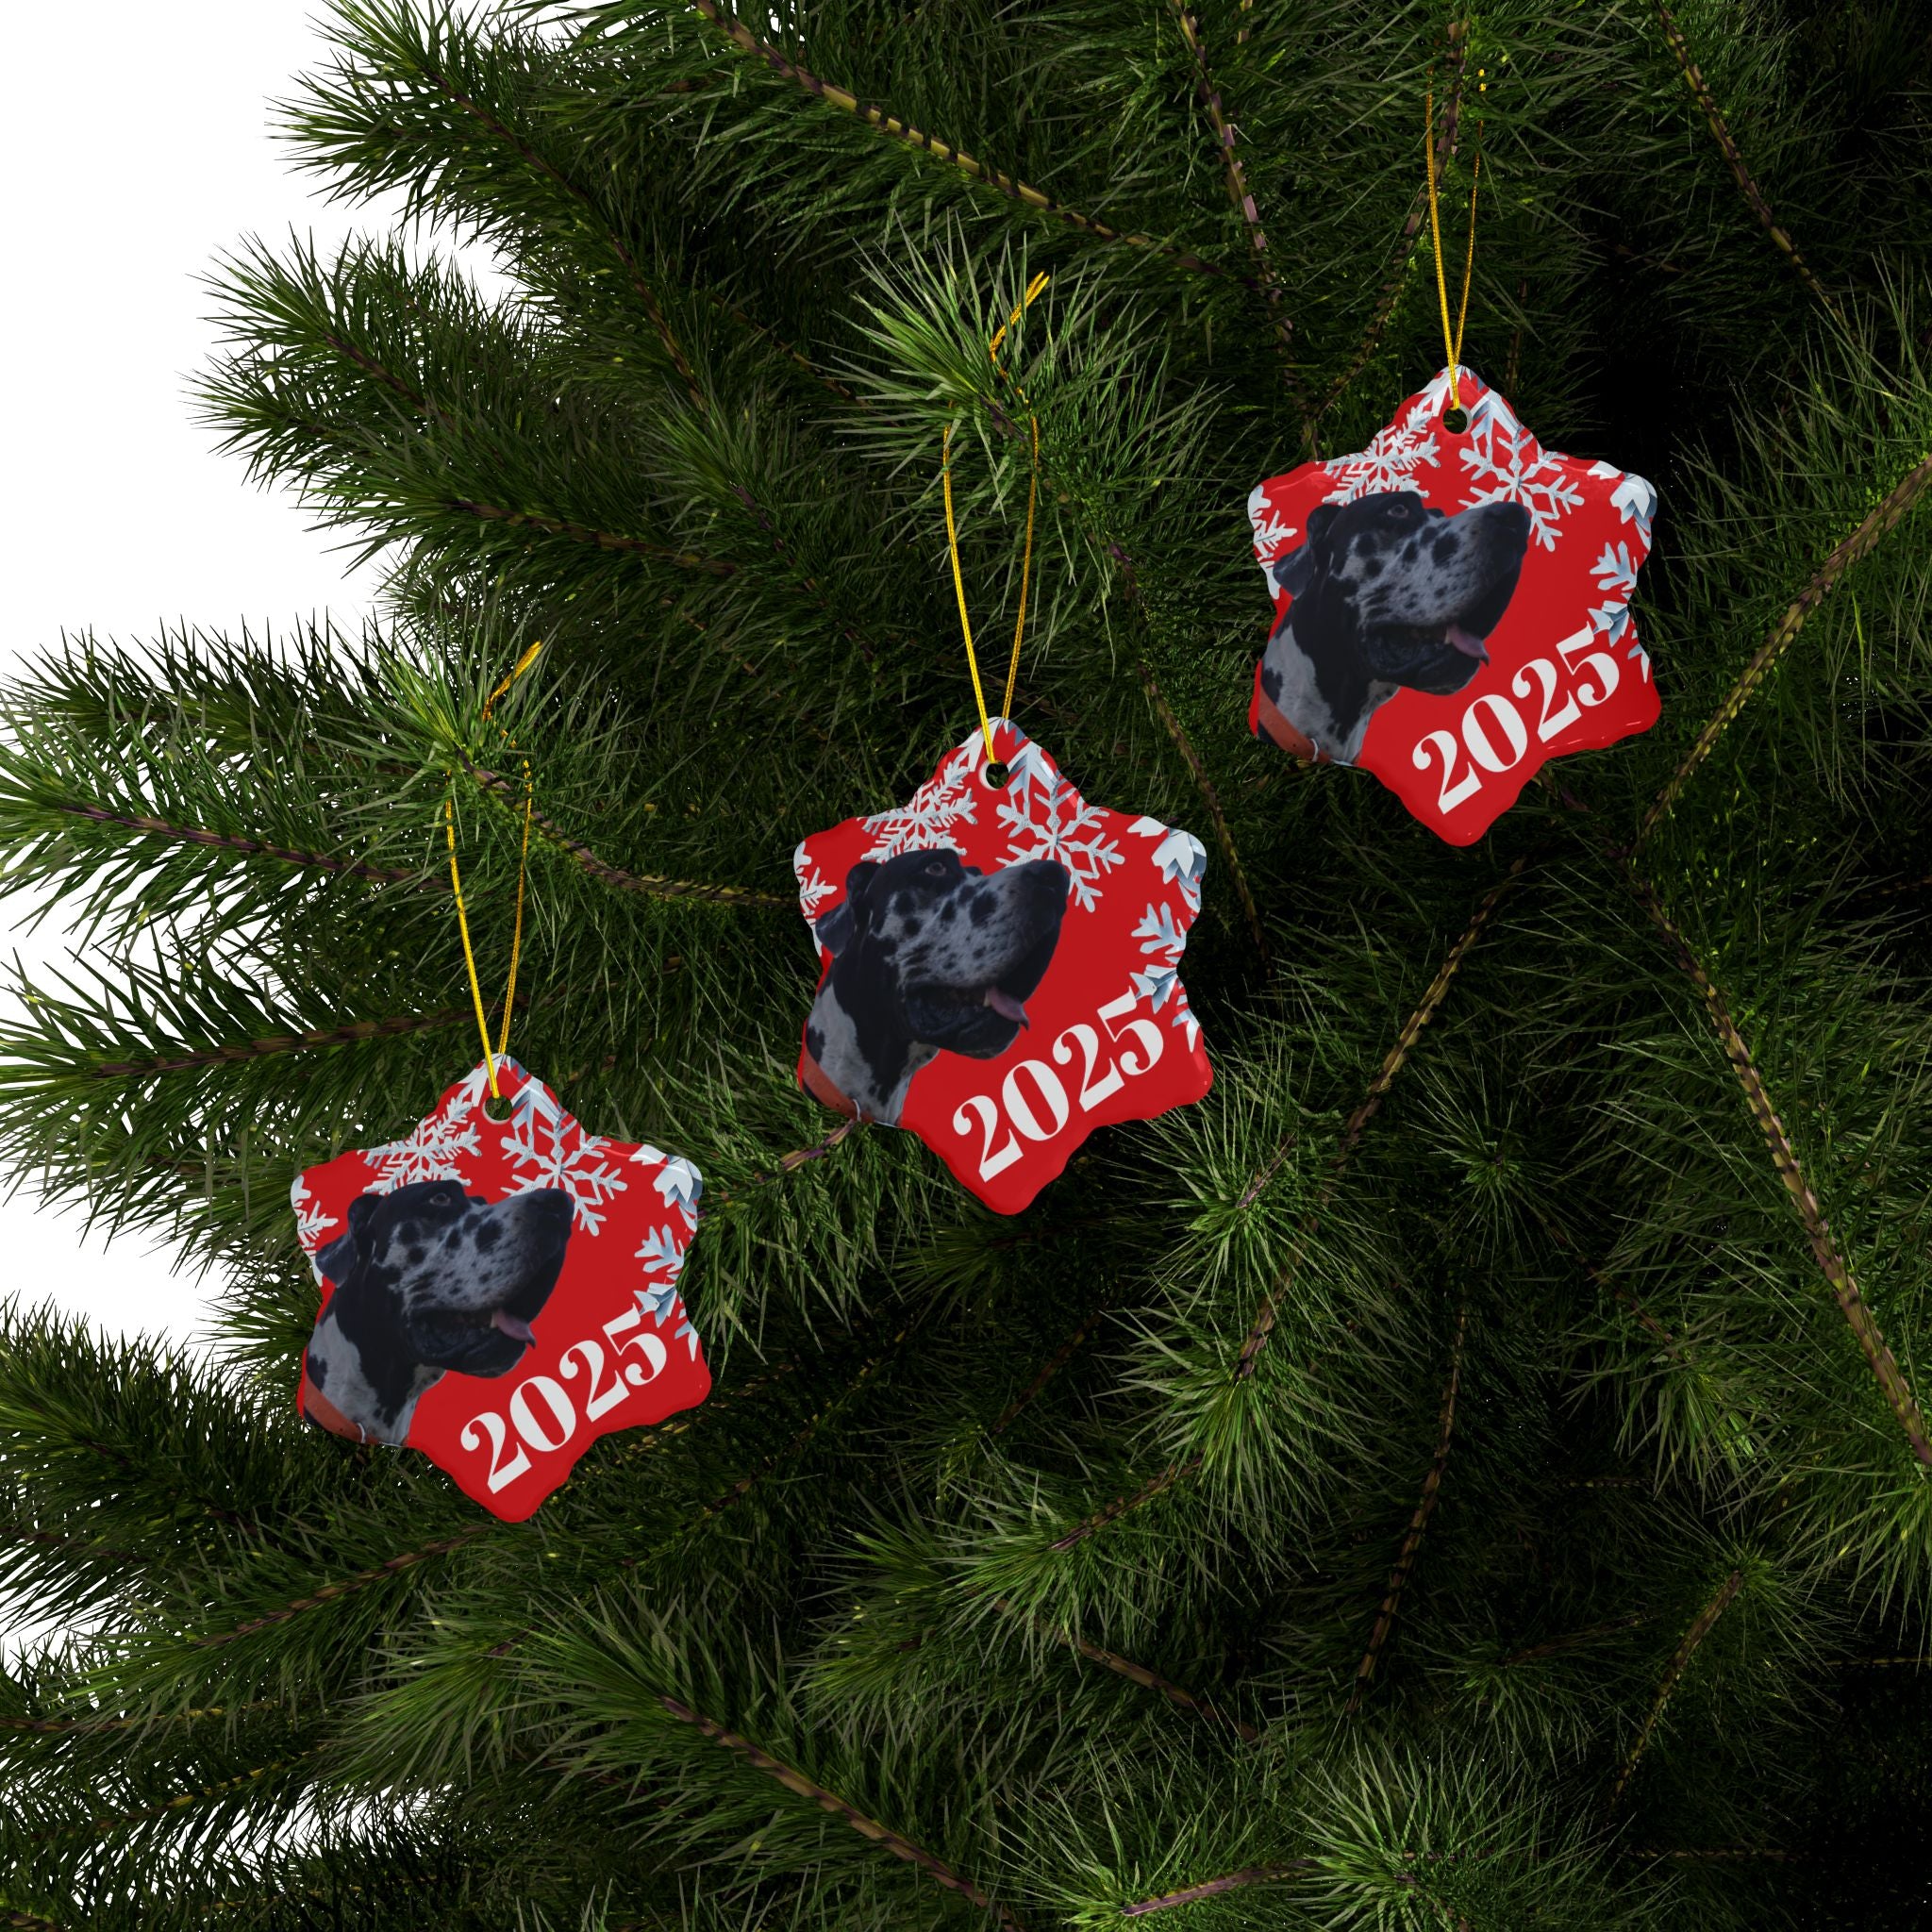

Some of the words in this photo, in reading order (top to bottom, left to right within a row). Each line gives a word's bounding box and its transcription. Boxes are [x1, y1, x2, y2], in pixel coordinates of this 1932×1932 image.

[1412, 621, 1619, 814] 2025
[953, 986, 1163, 1182] 2025
[460, 1303, 666, 1494] 2025
